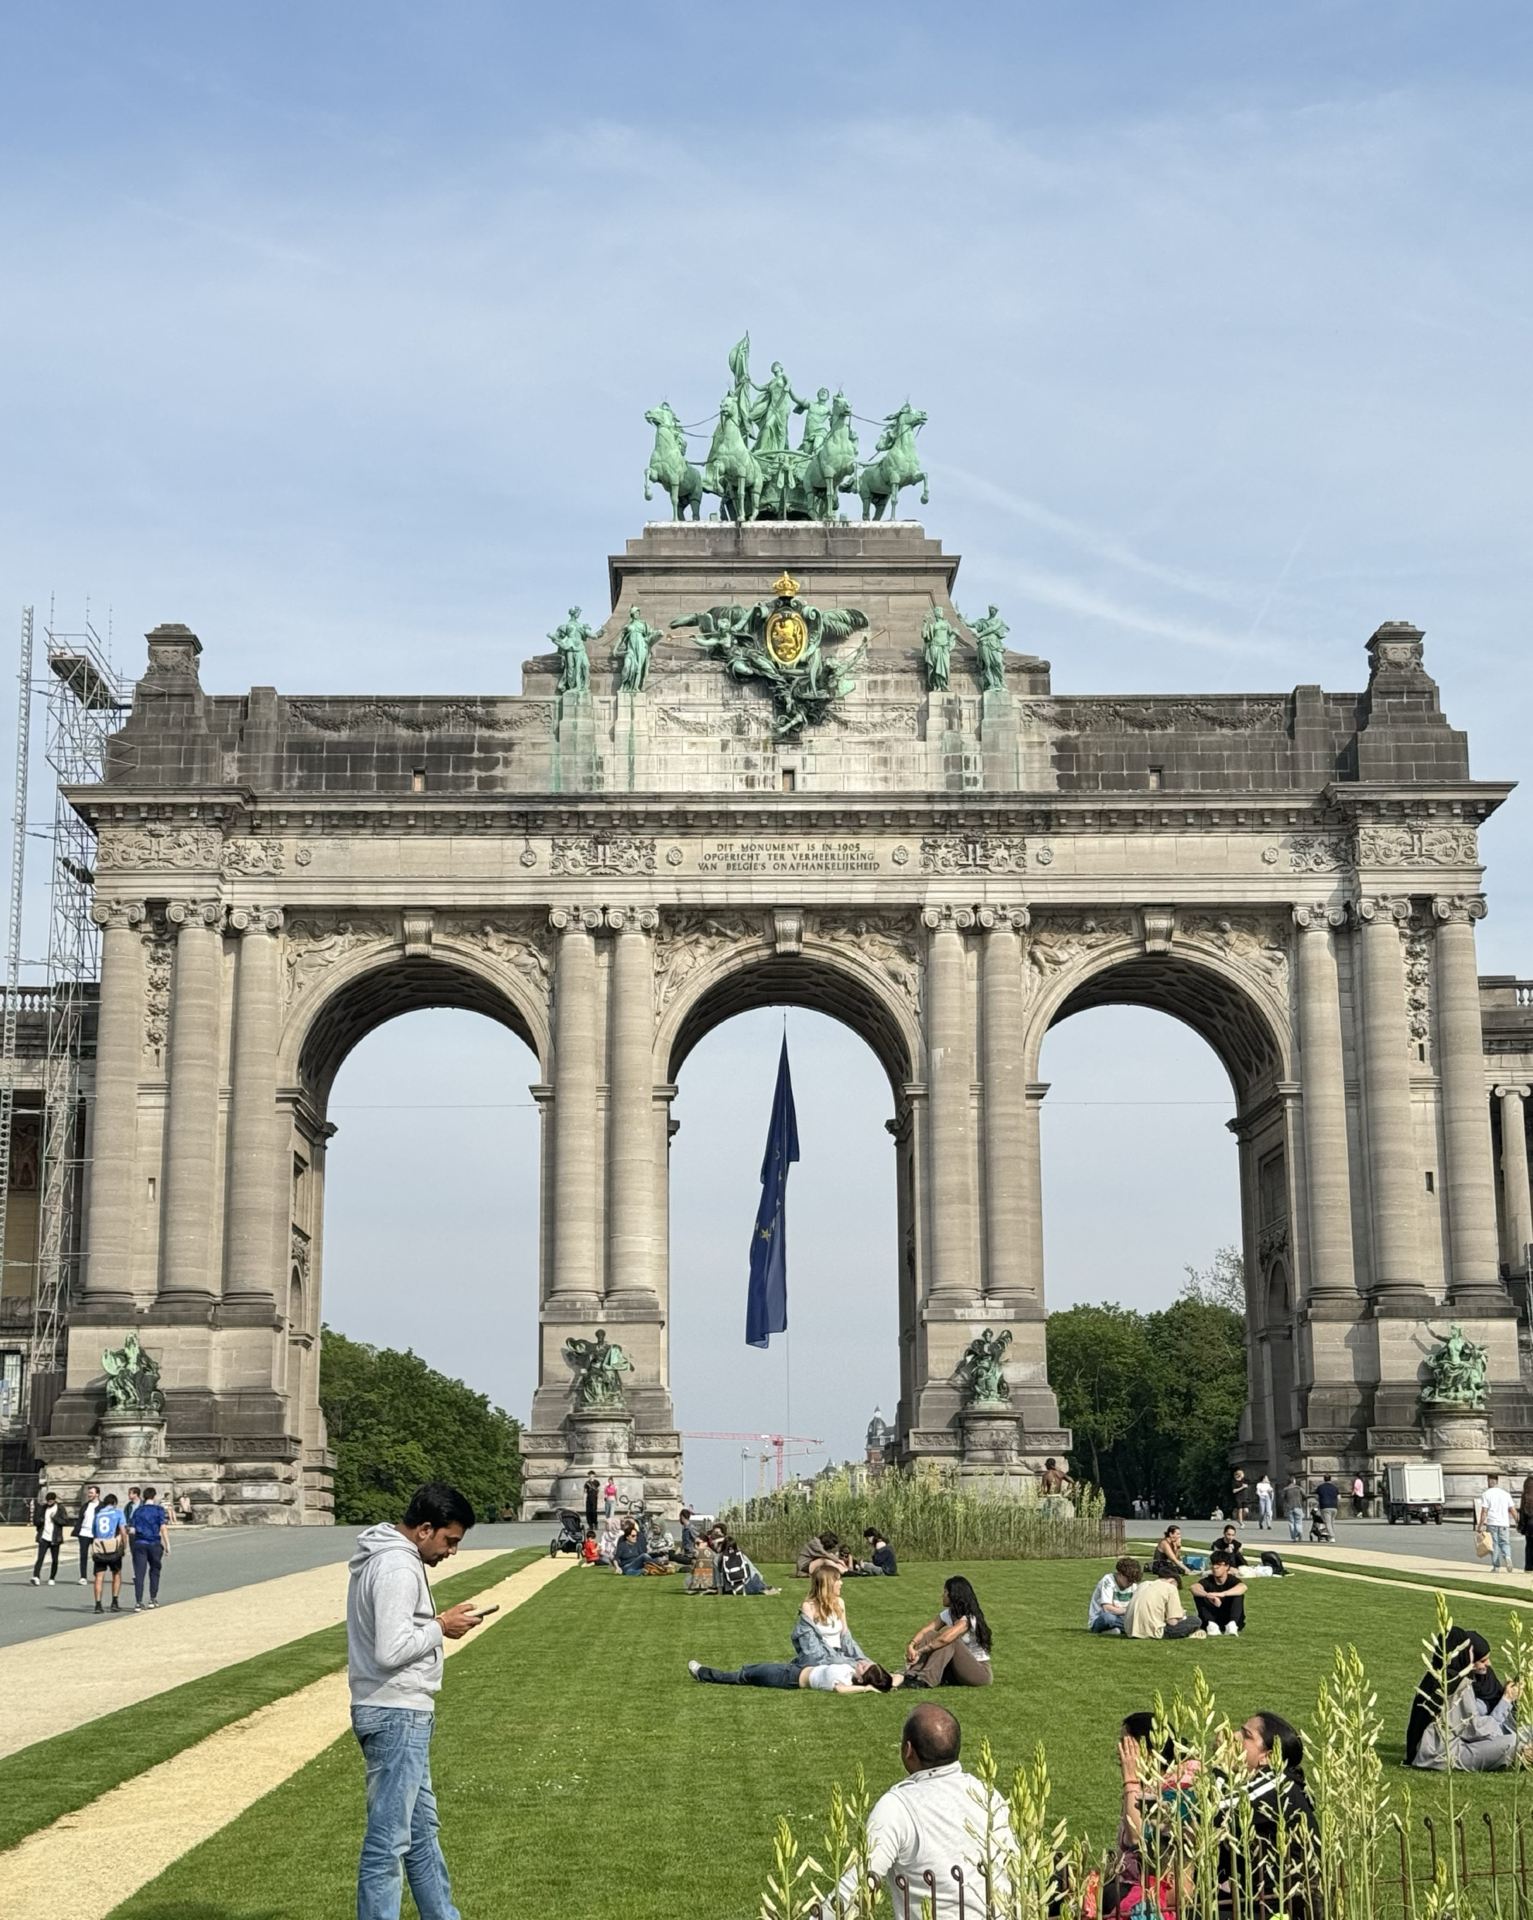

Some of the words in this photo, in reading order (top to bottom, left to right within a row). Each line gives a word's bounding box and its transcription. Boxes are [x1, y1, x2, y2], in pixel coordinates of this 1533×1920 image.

[717, 843, 734, 852] DIT
[741, 843, 800, 852] MONUMENT
[807, 843, 815, 851] IS
[822, 843, 832, 851] IN
[838, 843, 860, 852] 1905
[704, 853, 760, 861] OPGERICHT
[767, 853, 785, 861] TER
[792, 853, 874, 861] VERHEERLIJKING
[698, 862, 717, 870] VAN
[773, 862, 880, 871] ONAFHANKELIJKHEID
[99, 1517, 110, 1534] 8
